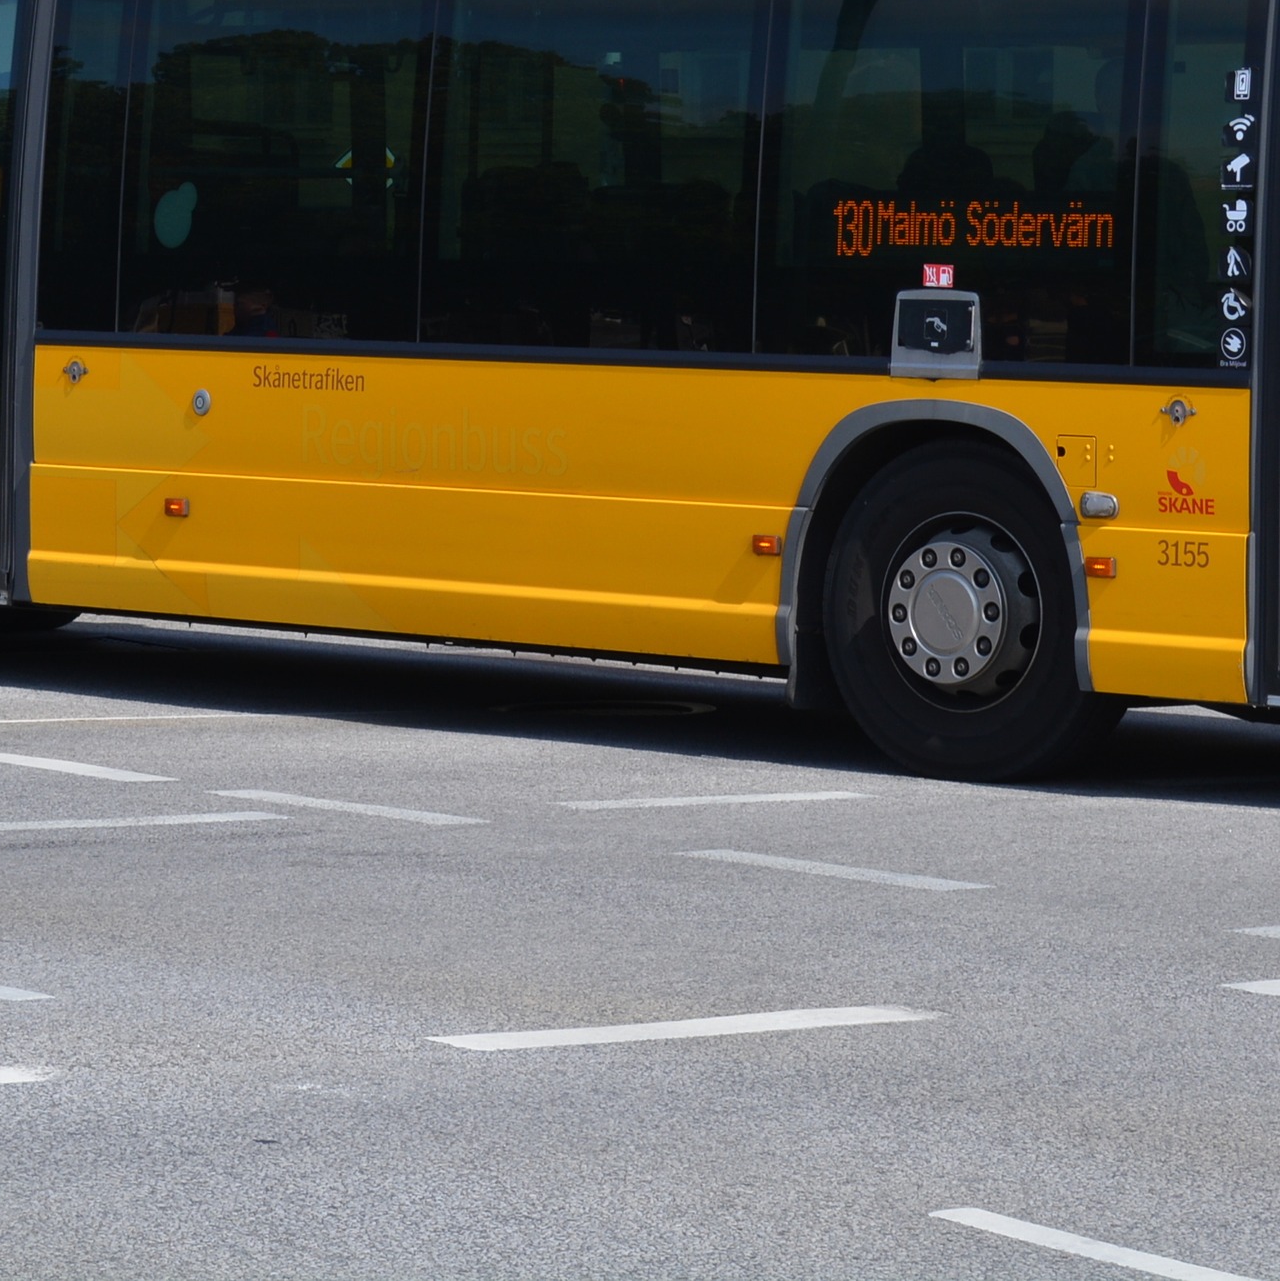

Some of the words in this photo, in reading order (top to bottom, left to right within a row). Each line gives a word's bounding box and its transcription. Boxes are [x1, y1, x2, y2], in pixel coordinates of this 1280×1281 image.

[833, 200, 873, 256] 130
[876, 200, 955, 246] Malmö
[966, 201, 1113, 247] Södervärn
[252, 364, 365, 392] Skånetrafiken
[1157, 539, 1210, 568] 3155
